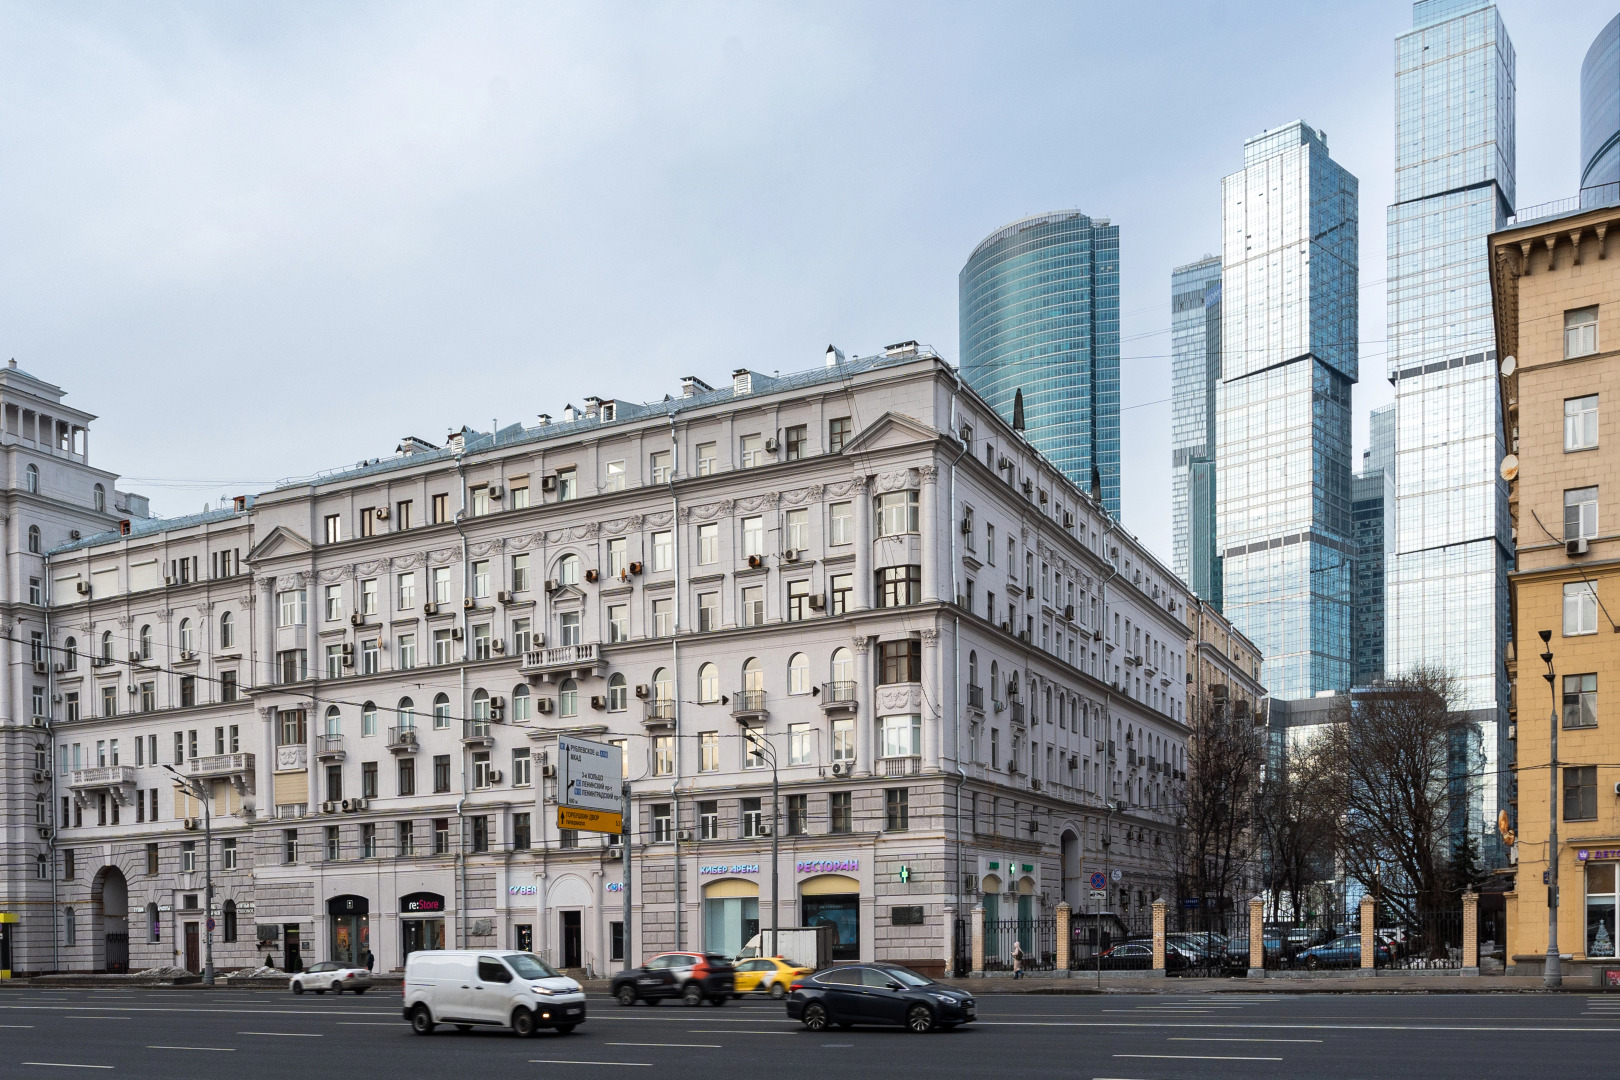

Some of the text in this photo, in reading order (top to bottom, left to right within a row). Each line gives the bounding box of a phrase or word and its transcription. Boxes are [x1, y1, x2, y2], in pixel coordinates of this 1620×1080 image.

[570, 754, 581, 762] МКАД
[700, 864, 760, 875] КИБЕР АРЕНА
[797, 859, 859, 873] РЕСТОРАН
[509, 885, 537, 895] CYBER
[408, 899, 439, 910] re:Store
